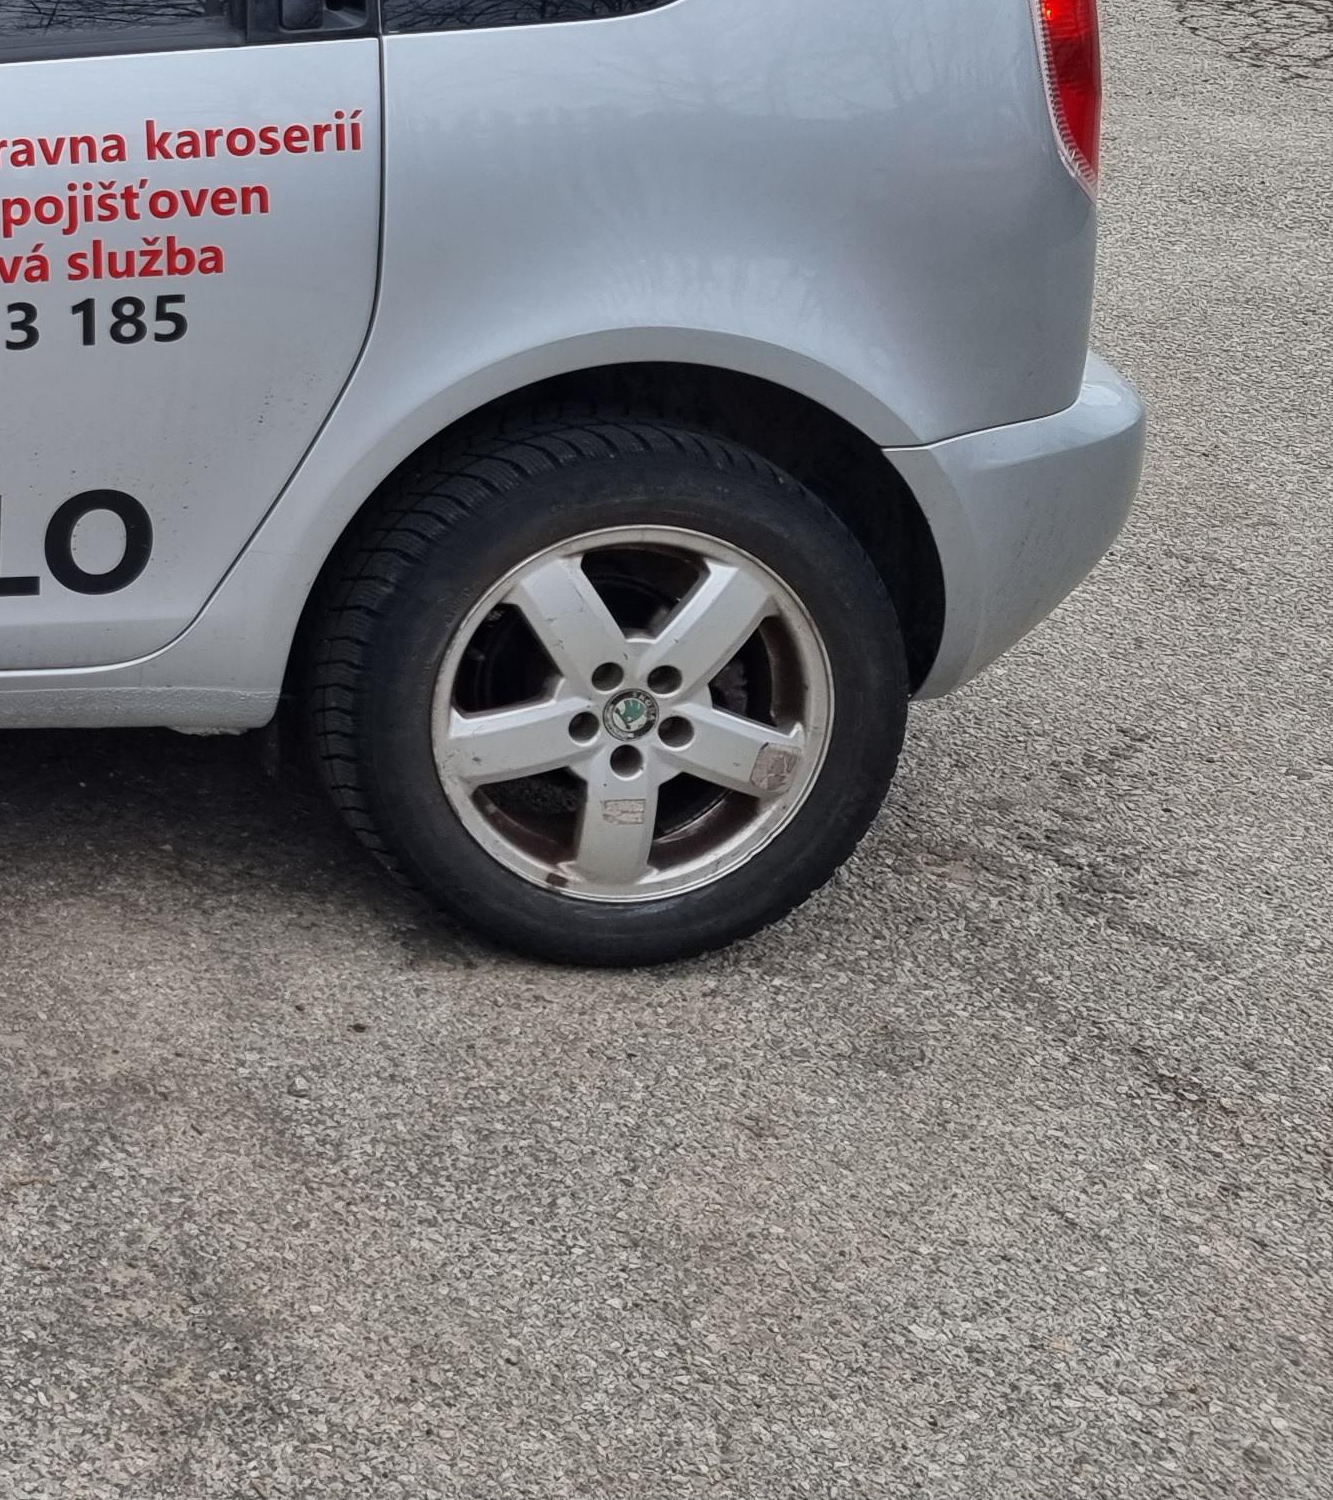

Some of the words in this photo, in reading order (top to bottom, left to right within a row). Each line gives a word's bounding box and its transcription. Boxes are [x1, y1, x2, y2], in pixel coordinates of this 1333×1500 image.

[145, 110, 363, 161] karoserií
[1, 178, 271, 239] pojišťoven
[66, 235, 225, 282] služba
[71, 294, 189, 347] 185
